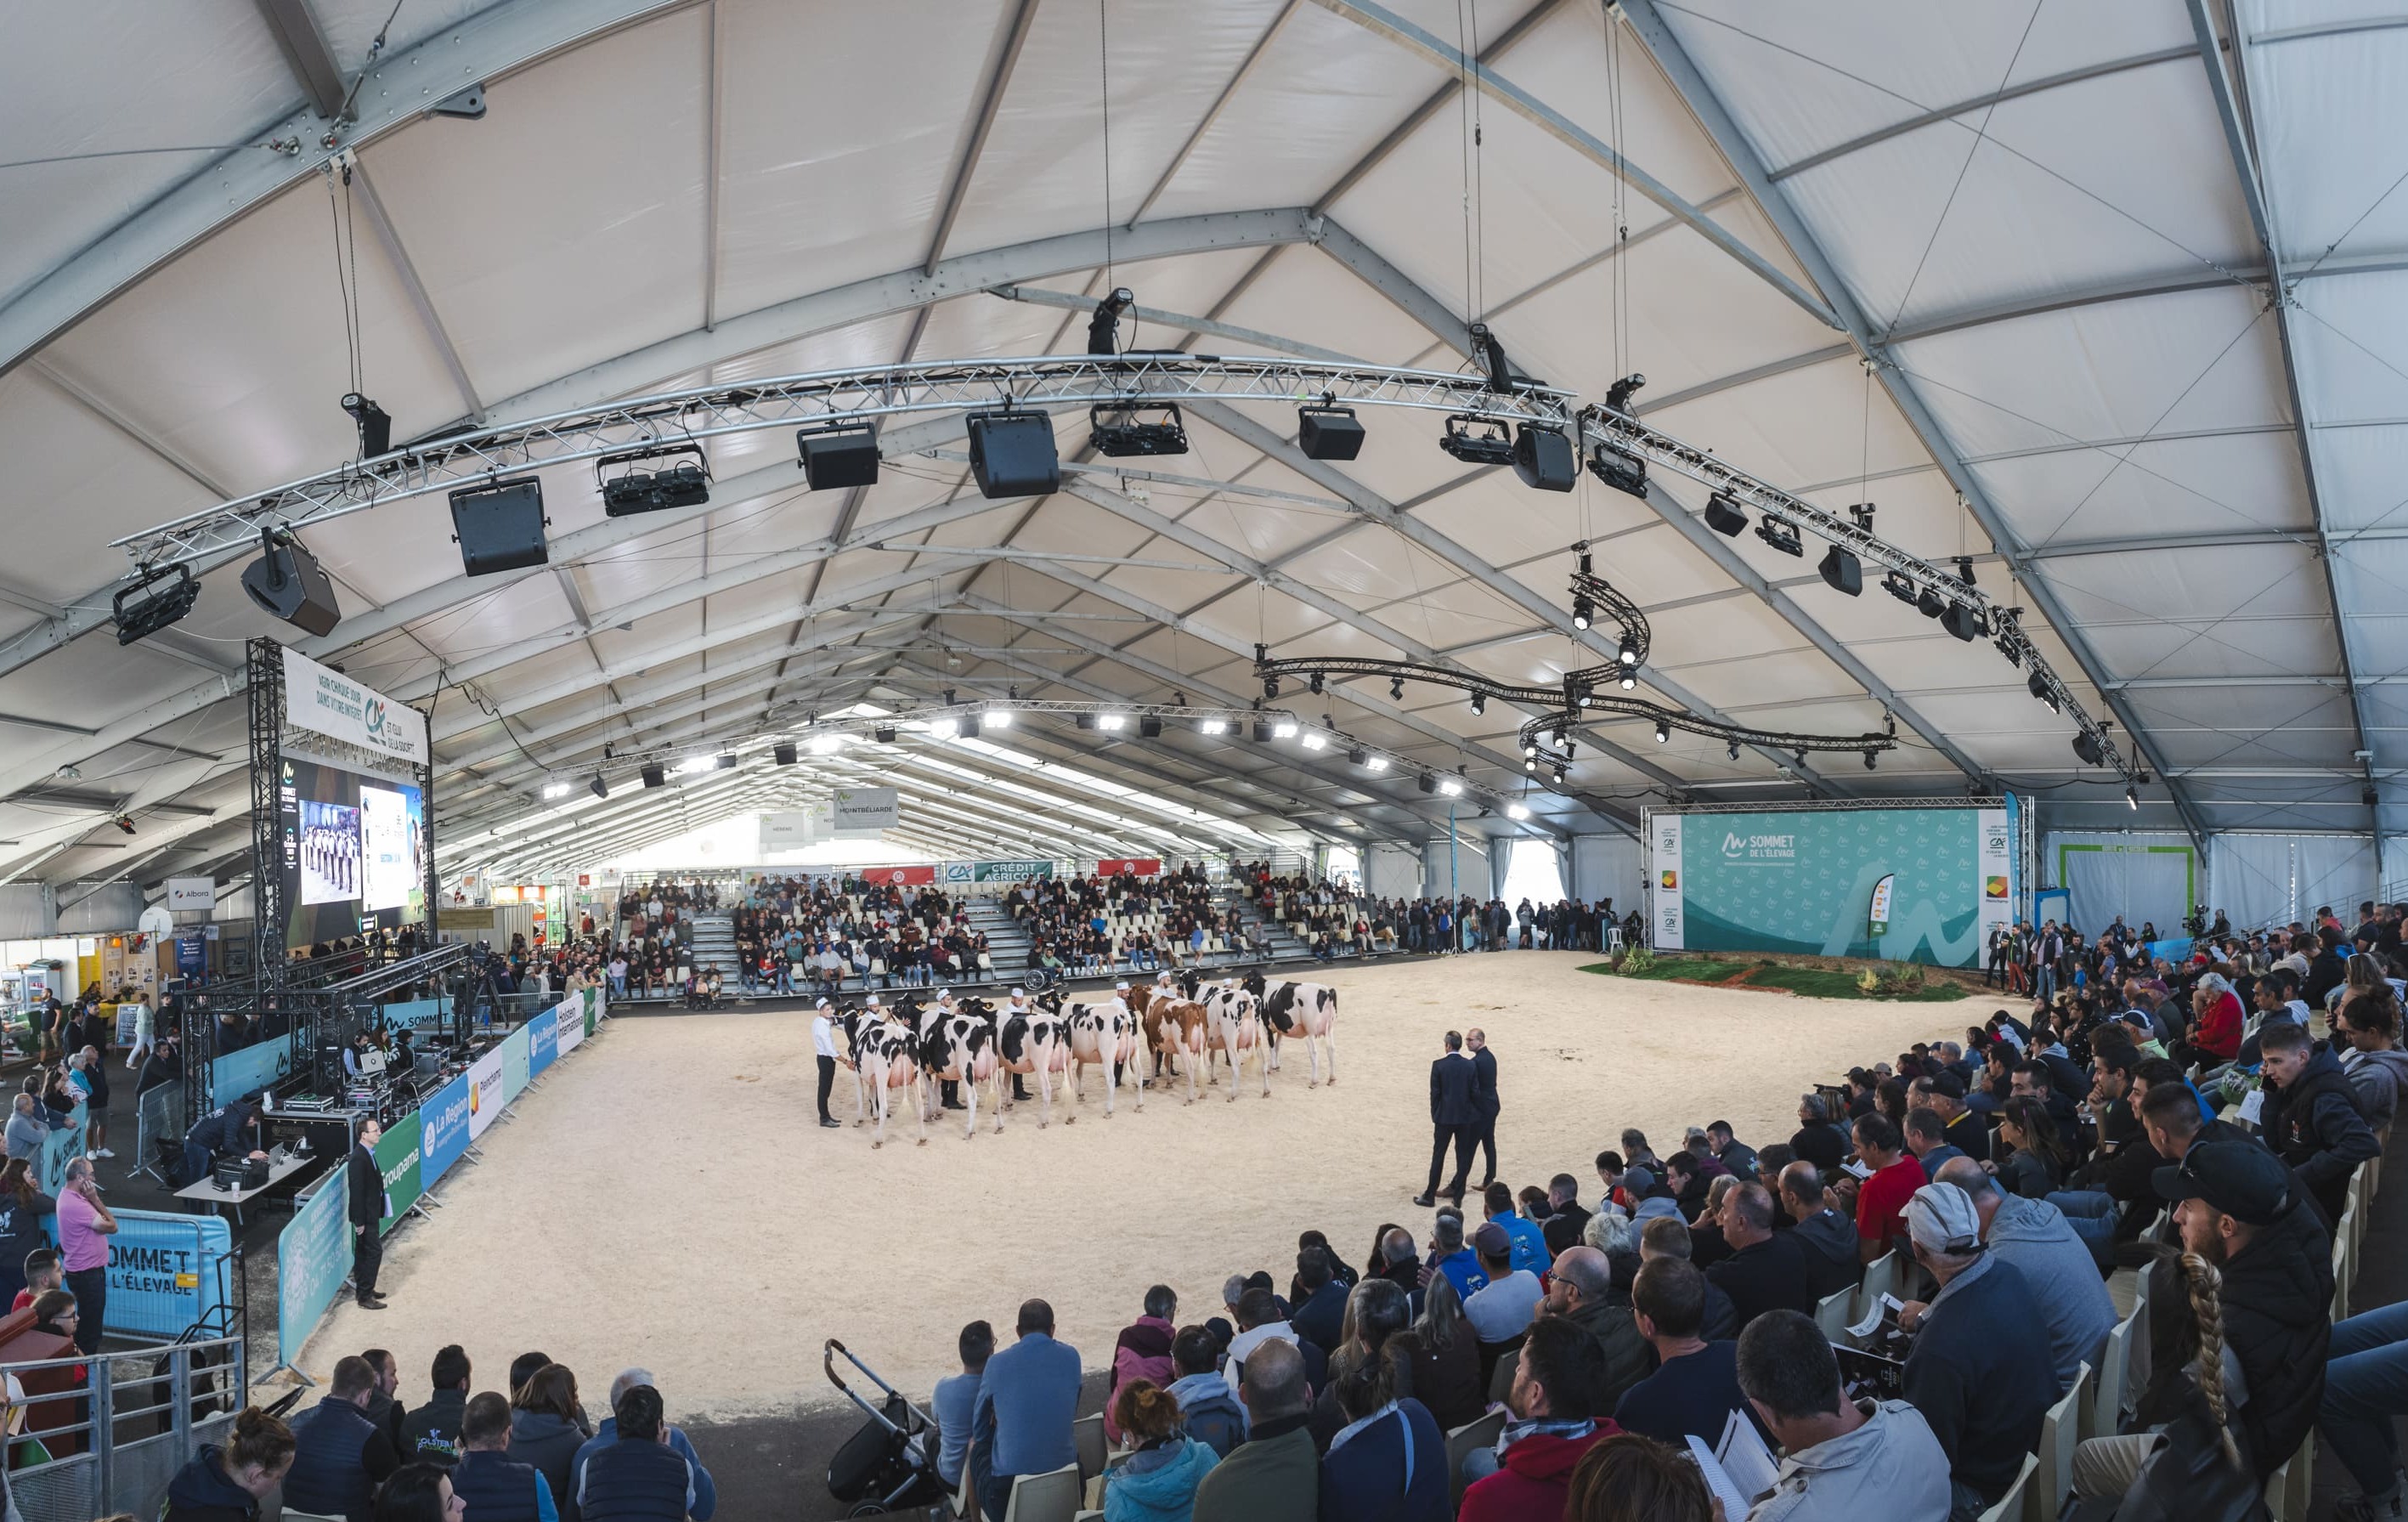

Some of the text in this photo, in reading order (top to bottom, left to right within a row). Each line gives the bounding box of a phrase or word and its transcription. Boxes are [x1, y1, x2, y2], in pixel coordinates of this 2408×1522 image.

[1749, 835, 1795, 848] SOMMET
[1749, 847, 1795, 857] DE L'ÉLEVAGE
[992, 863, 1037, 873] CRÉDIT
[185, 890, 209, 898] Albora
[558, 1004, 576, 1024] Holstein
[557, 1016, 585, 1040] International
[537, 1030, 544, 1044] La
[436, 1096, 467, 1135] La Région
[108, 1244, 191, 1274] OMMET
